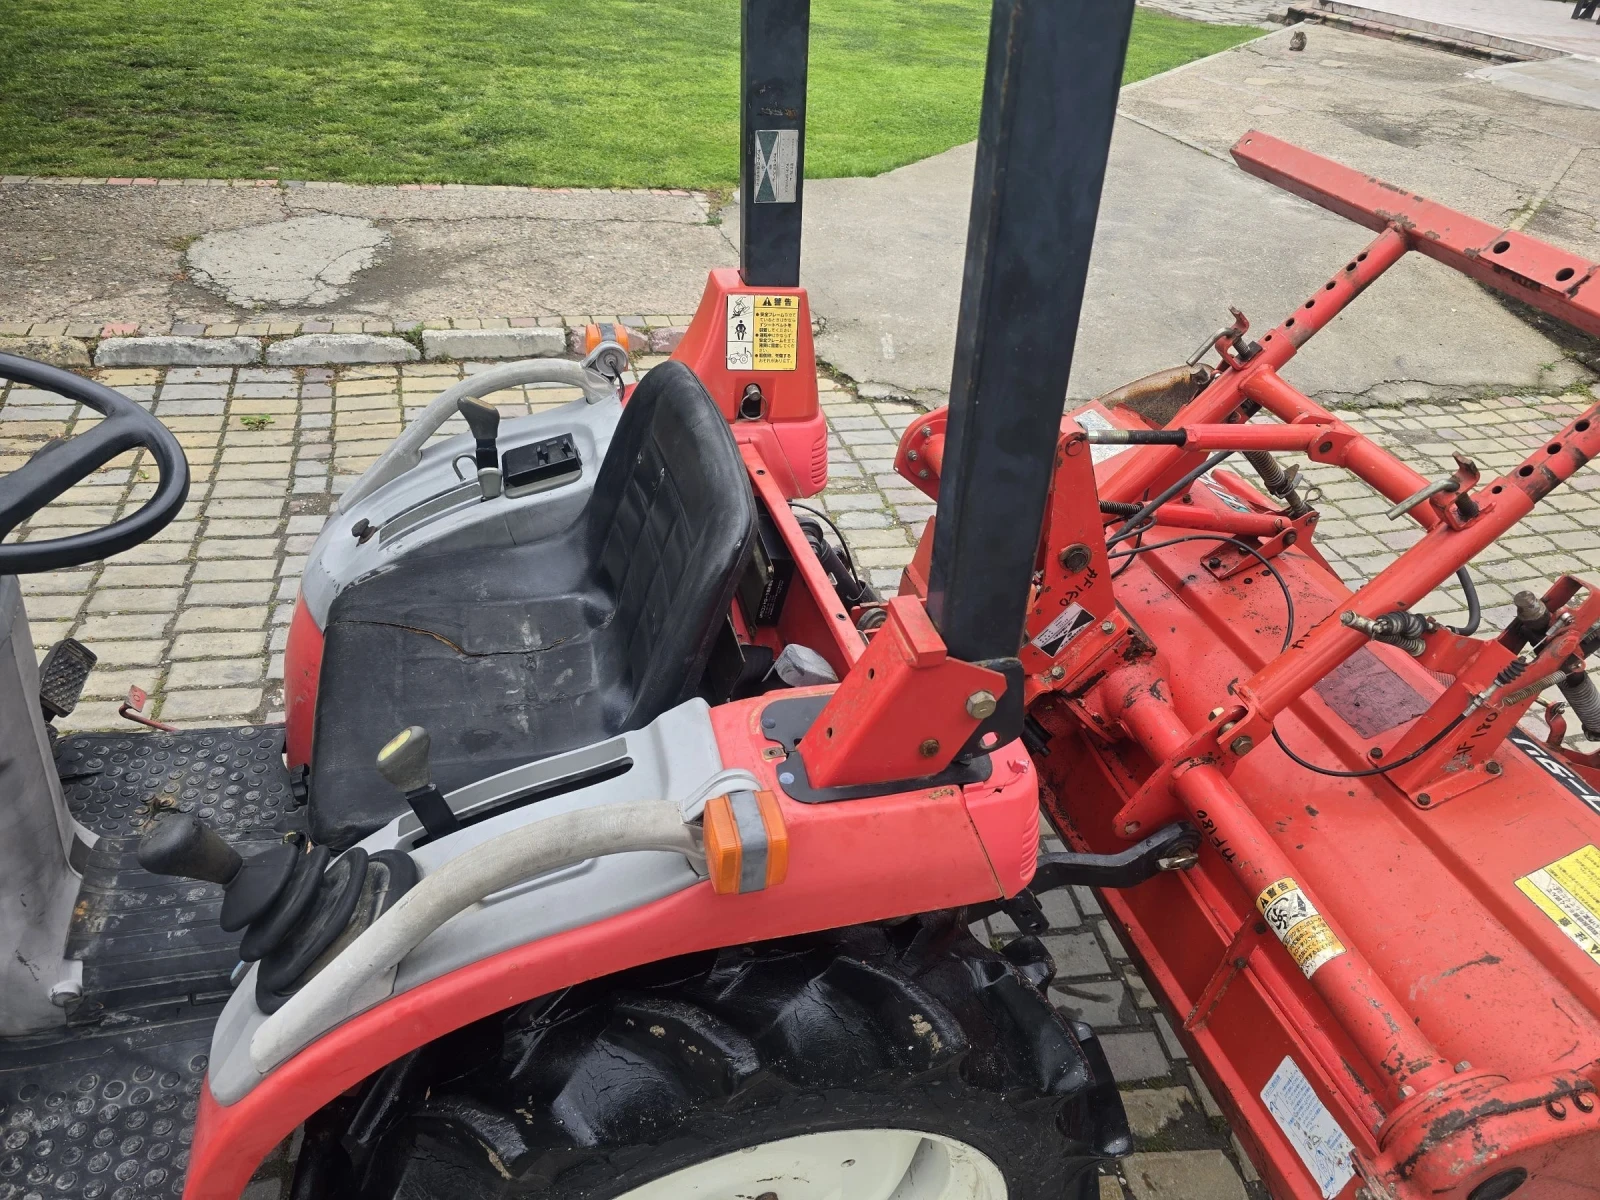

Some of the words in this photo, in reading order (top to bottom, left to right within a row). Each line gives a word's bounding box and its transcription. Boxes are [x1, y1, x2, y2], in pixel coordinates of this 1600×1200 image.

[774, 298, 792, 306] 警告
[1266, 880, 1288, 898] 警告
[1557, 915, 1588, 944] 注意
